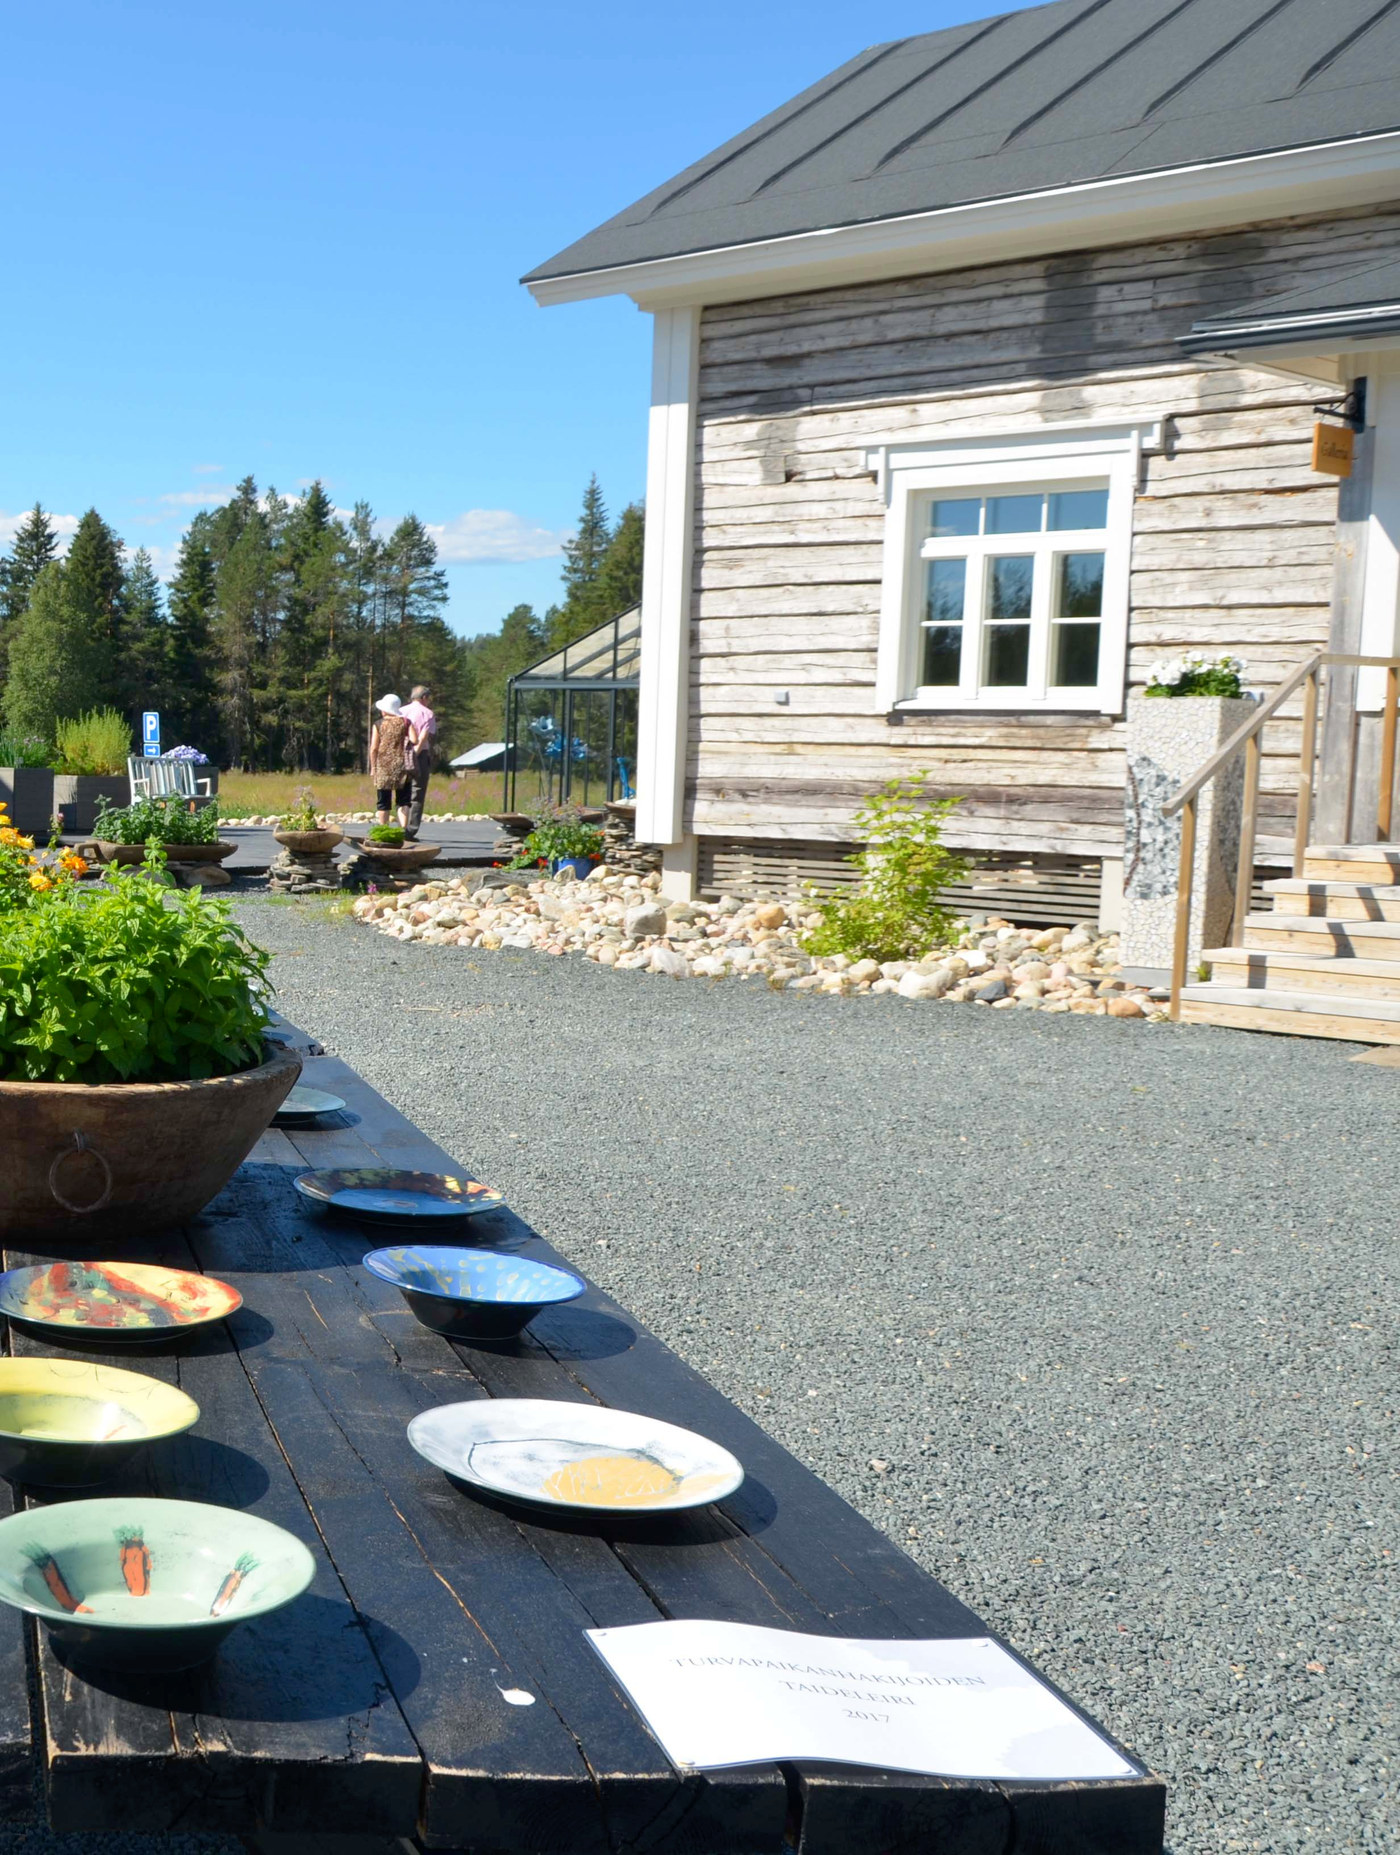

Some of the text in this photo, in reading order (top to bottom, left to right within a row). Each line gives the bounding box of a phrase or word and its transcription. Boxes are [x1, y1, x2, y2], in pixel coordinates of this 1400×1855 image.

[146, 715, 157, 740] P
[669, 1656, 986, 1686] TURVAPAIKANHAKIJOIDEN
[778, 1680, 915, 1705] TAIDELEIRI
[841, 1709, 890, 1723] 2017
